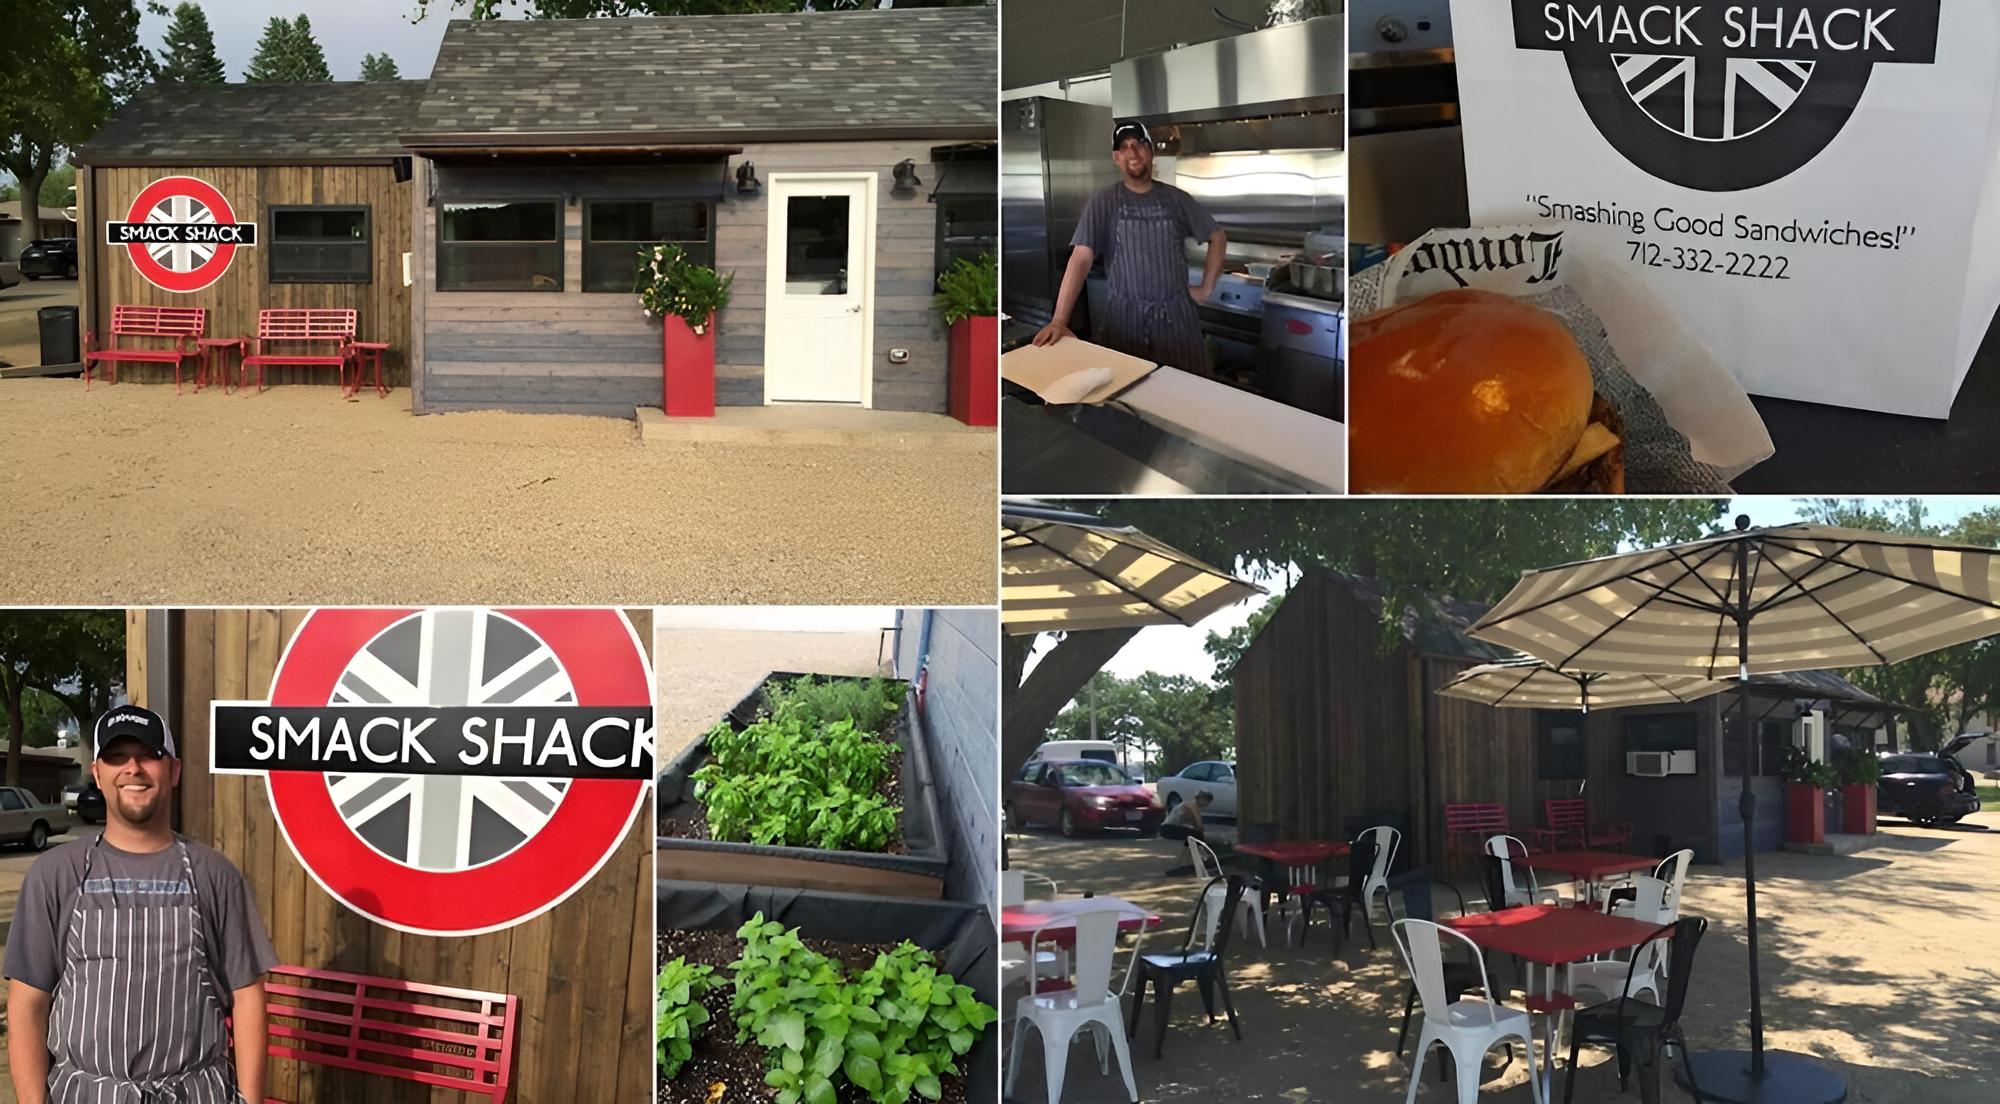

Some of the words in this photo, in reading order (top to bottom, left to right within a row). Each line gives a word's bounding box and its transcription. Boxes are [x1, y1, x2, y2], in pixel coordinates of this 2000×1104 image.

[1544, 3, 1703, 47] SMACK
[1722, 6, 1897, 51] SHACK
[119, 225, 180, 242] SMACK
[184, 225, 243, 242] SHACK
[1653, 207, 1724, 238] Good
[1402, 230, 1565, 289] Londo
[1625, 240, 1791, 280] 712-332-2222
[248, 714, 438, 764] SMACK
[457, 716, 654, 769] SHACK
